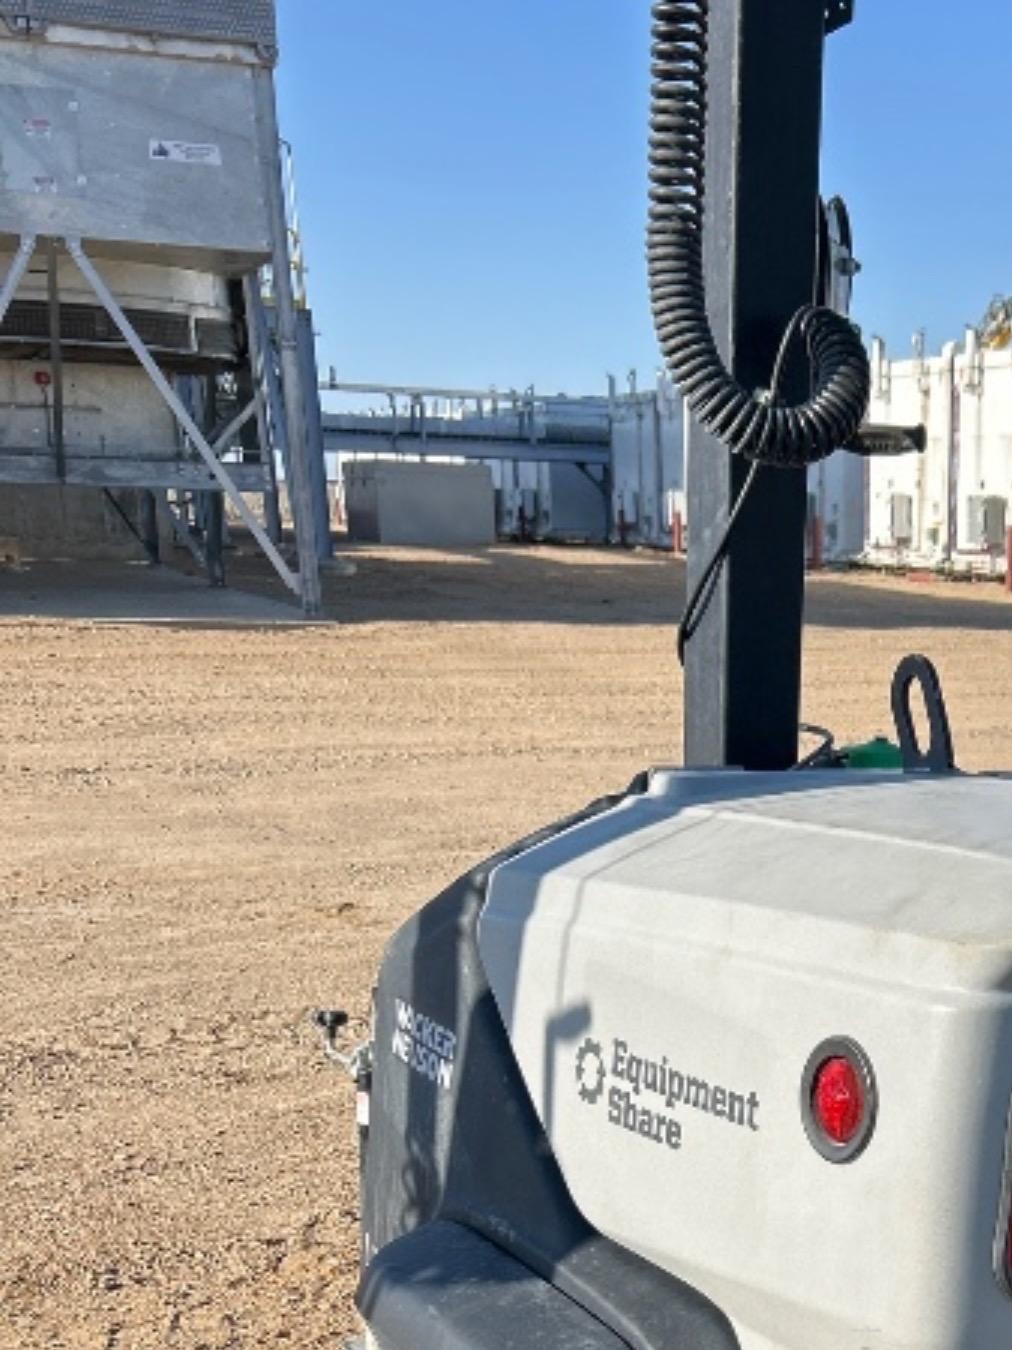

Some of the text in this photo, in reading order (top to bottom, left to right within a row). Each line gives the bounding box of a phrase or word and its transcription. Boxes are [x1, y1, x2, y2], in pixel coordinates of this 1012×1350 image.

[395, 998, 456, 1060] WACKER
[611, 1038, 760, 1130] Equipment
[608, 1090, 682, 1149] Share
